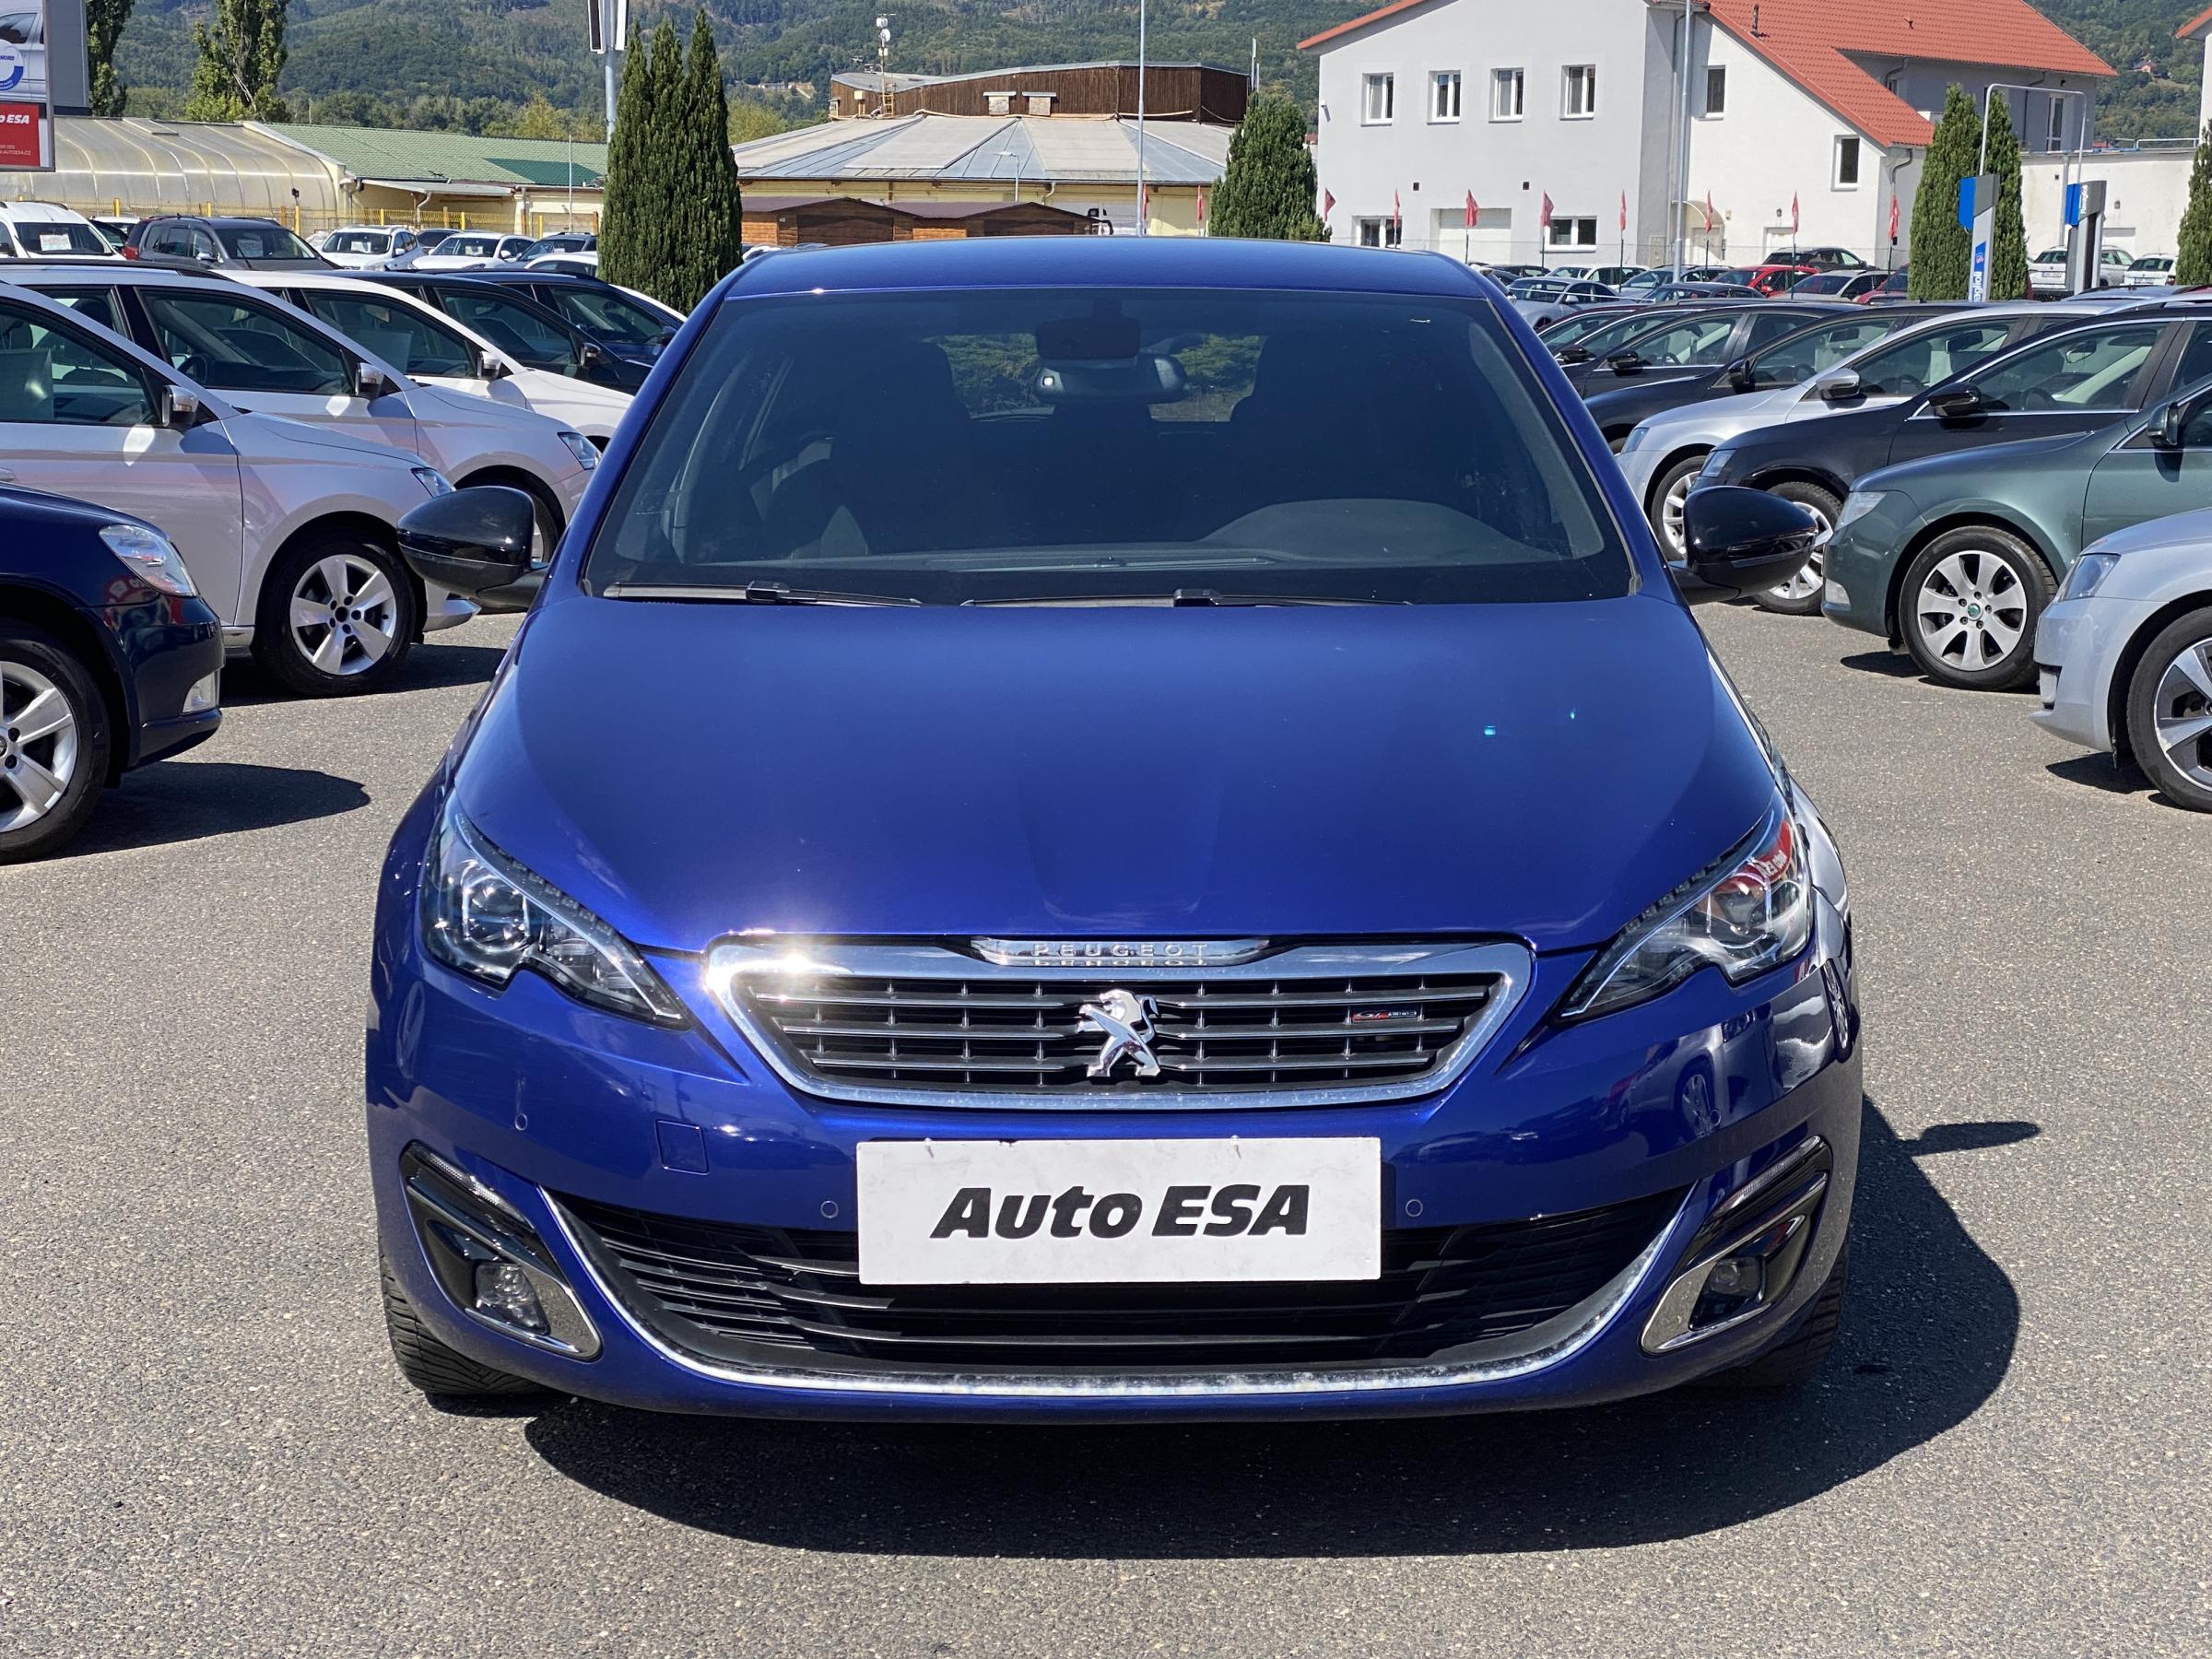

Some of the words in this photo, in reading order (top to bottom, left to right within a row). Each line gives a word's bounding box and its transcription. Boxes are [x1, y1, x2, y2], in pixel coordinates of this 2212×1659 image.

[6, 114, 29, 124] ESA
[1032, 943, 1208, 957] PEUGEOT
[929, 1185, 1143, 1240] Auto
[1151, 1183, 1311, 1238] ESA
